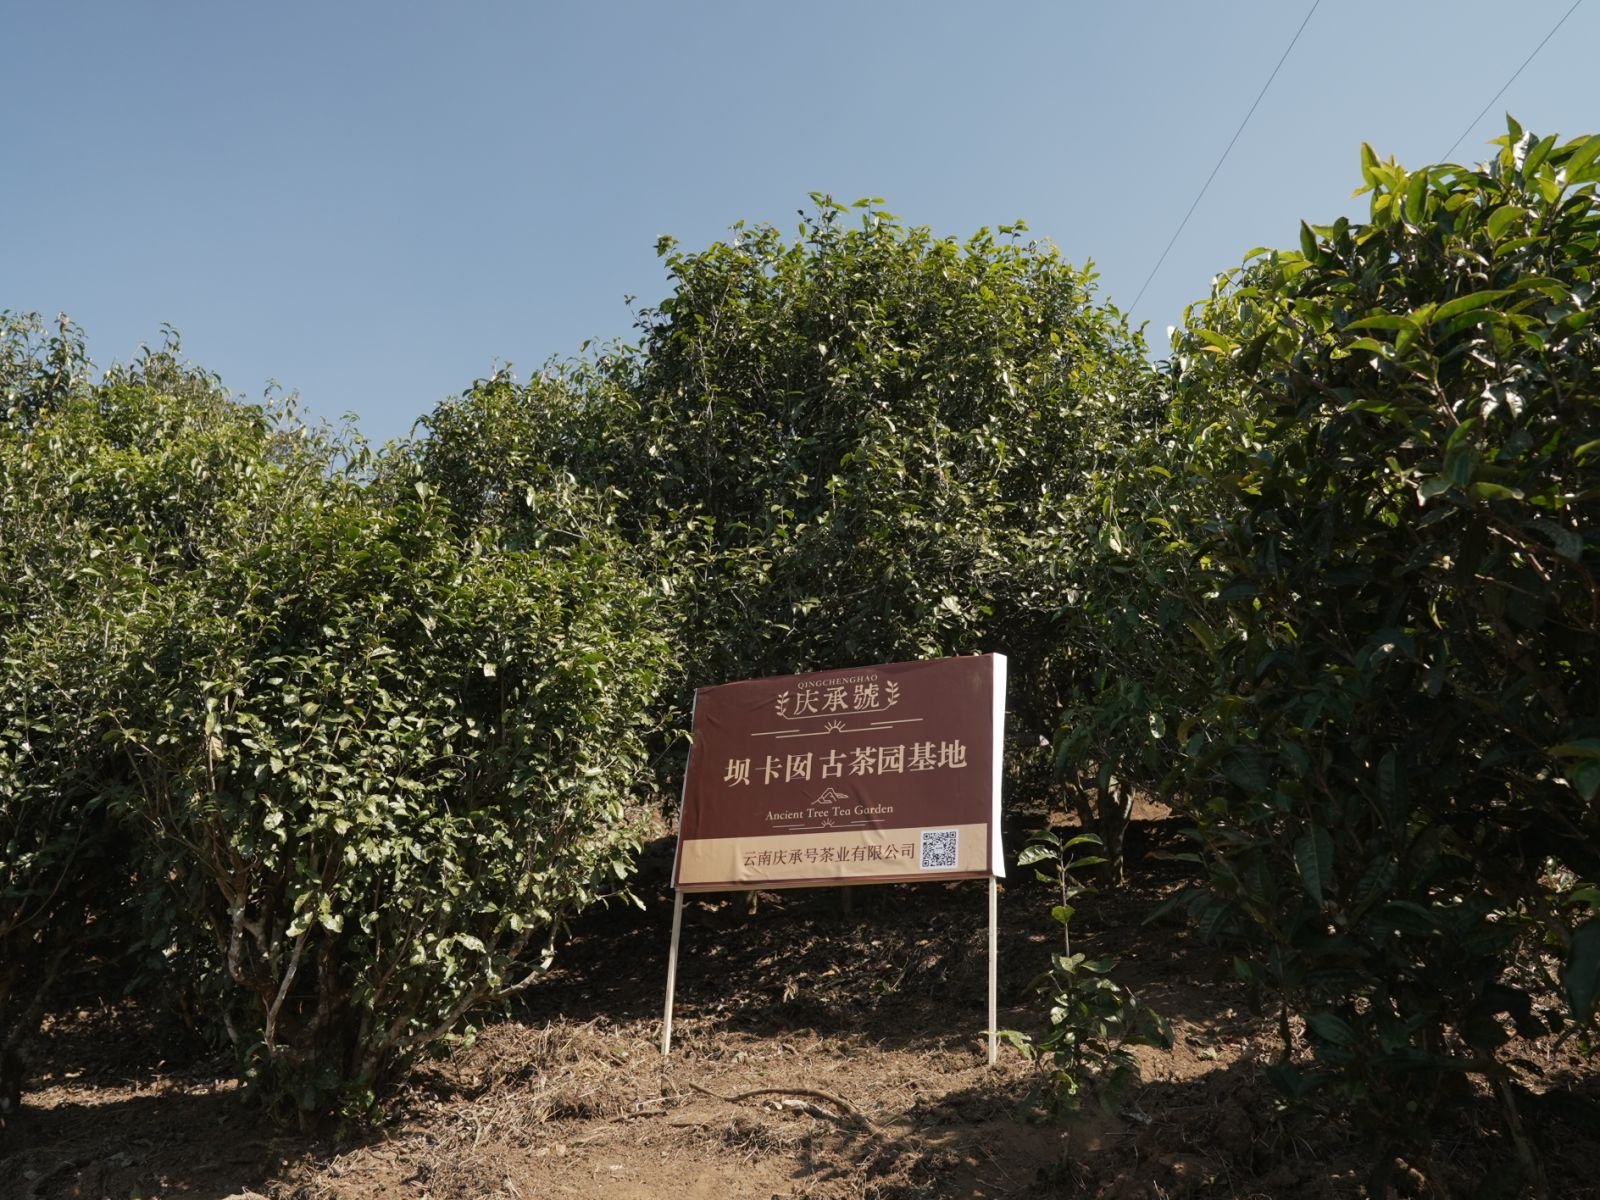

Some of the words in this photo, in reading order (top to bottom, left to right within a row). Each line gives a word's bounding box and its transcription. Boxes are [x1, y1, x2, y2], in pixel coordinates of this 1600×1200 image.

[797, 674, 878, 689] QINGCHENGHAO
[765, 809, 803, 821] Ancient
[807, 807, 829, 818] Tree
[832, 806, 851, 816] Tea
[854, 804, 894, 815] Garden
[743, 842, 916, 867] 云南庆承号茶业有限公司
